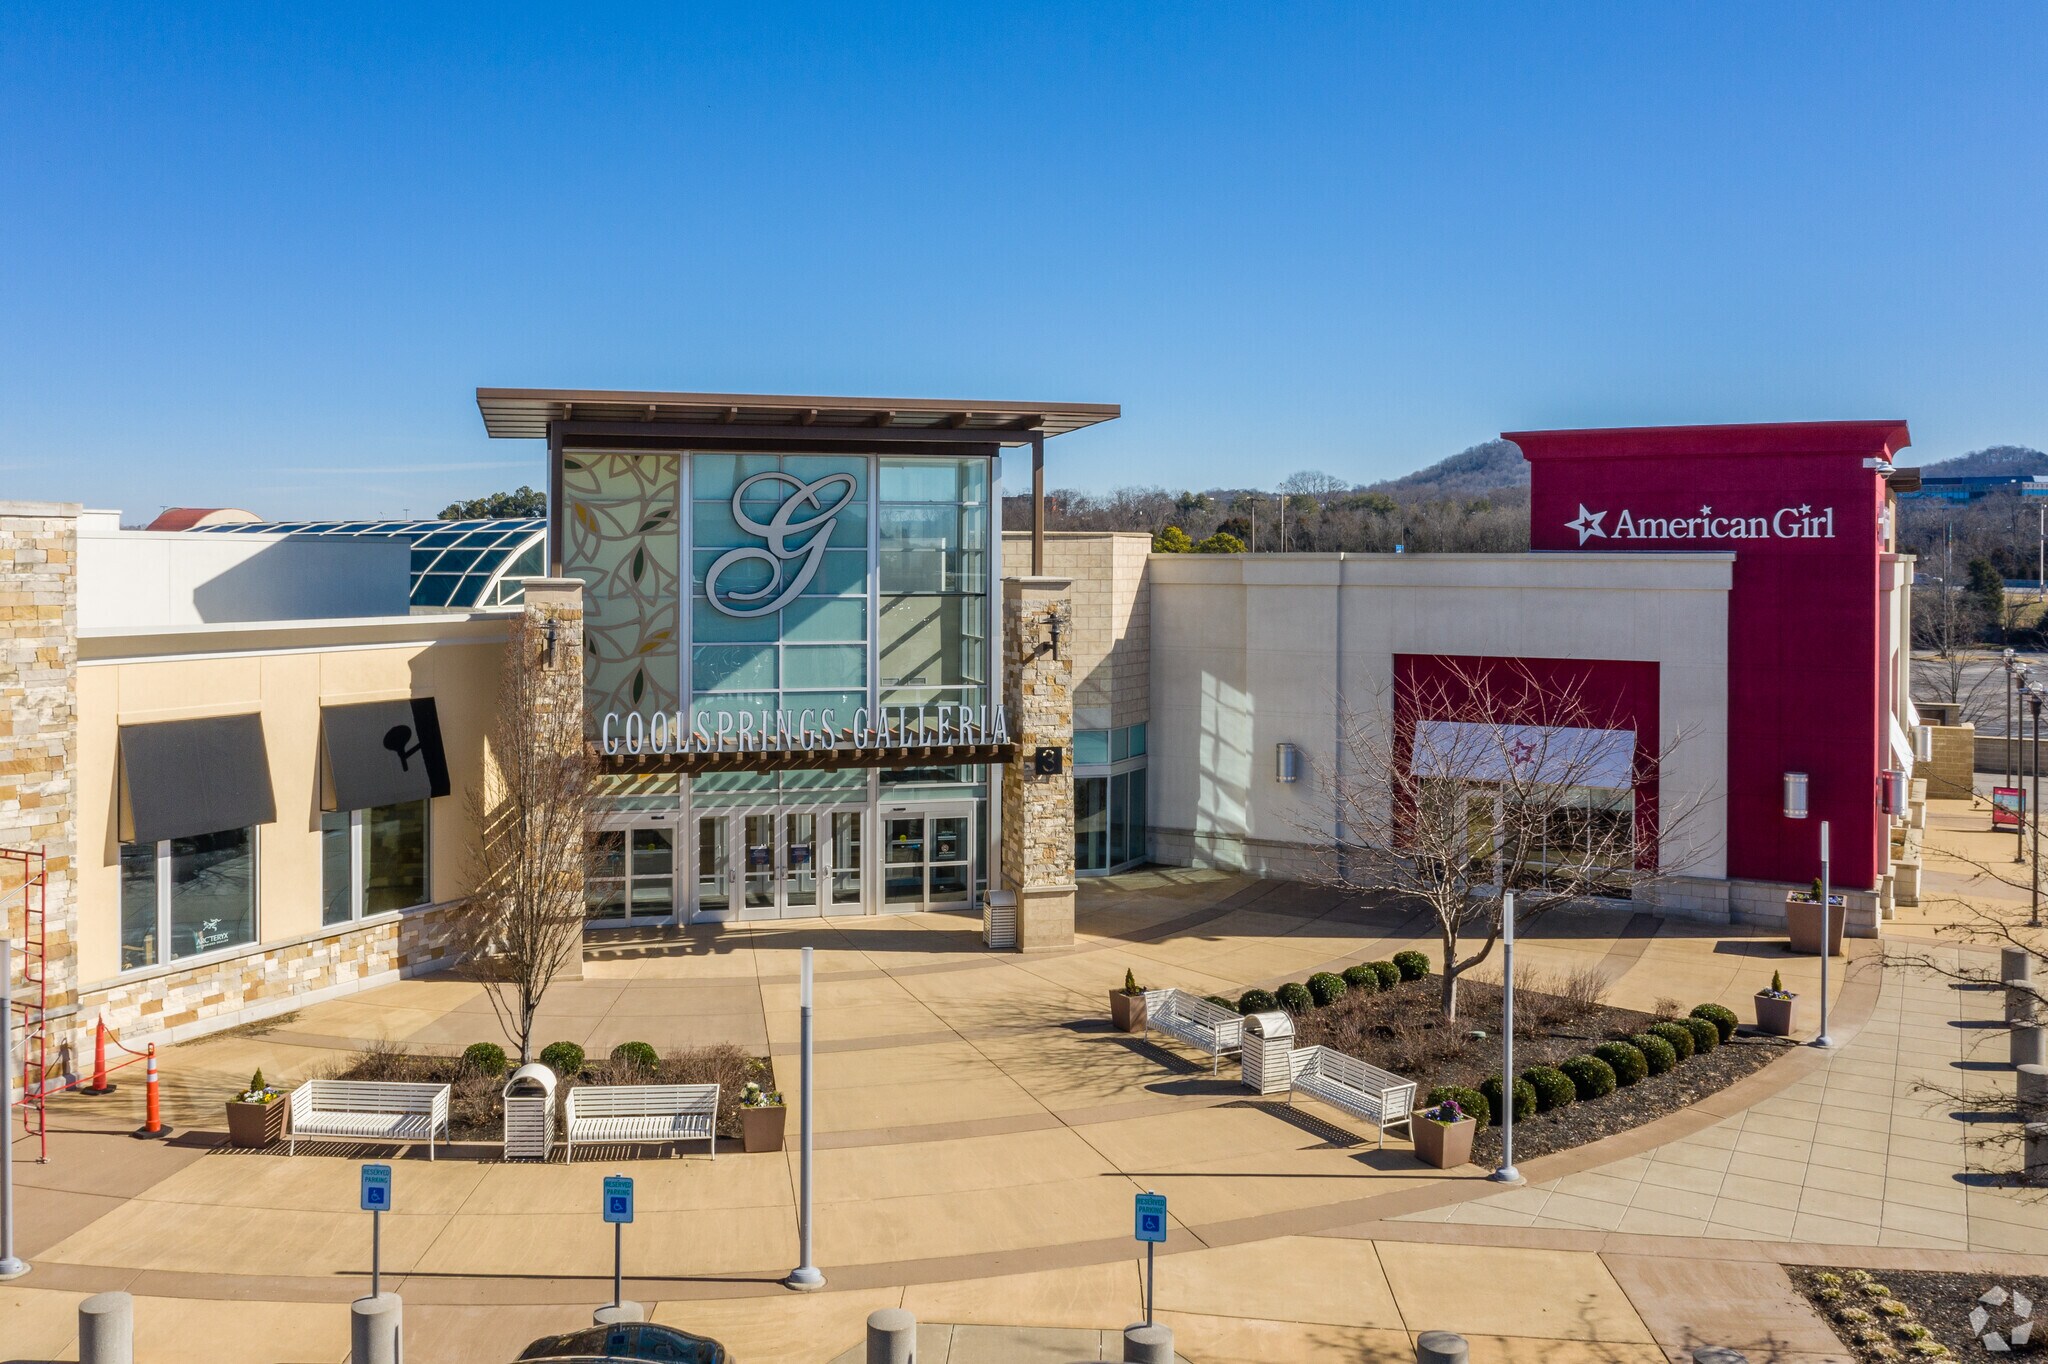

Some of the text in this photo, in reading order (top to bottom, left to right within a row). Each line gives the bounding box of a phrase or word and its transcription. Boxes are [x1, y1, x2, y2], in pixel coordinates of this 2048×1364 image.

[1610, 503, 1836, 539] American Girl
[602, 704, 1008, 755] COOLSPRINGS GALLERIA
[1042, 749, 1055, 772] 3
[363, 1168, 390, 1176] RESERVED
[364, 1176, 388, 1184] PARKING
[605, 1180, 632, 1188] RESERVED
[607, 1188, 630, 1196] PARKING
[1136, 1198, 1165, 1206] RESERVED
[1138, 1206, 1163, 1214] PARKING
